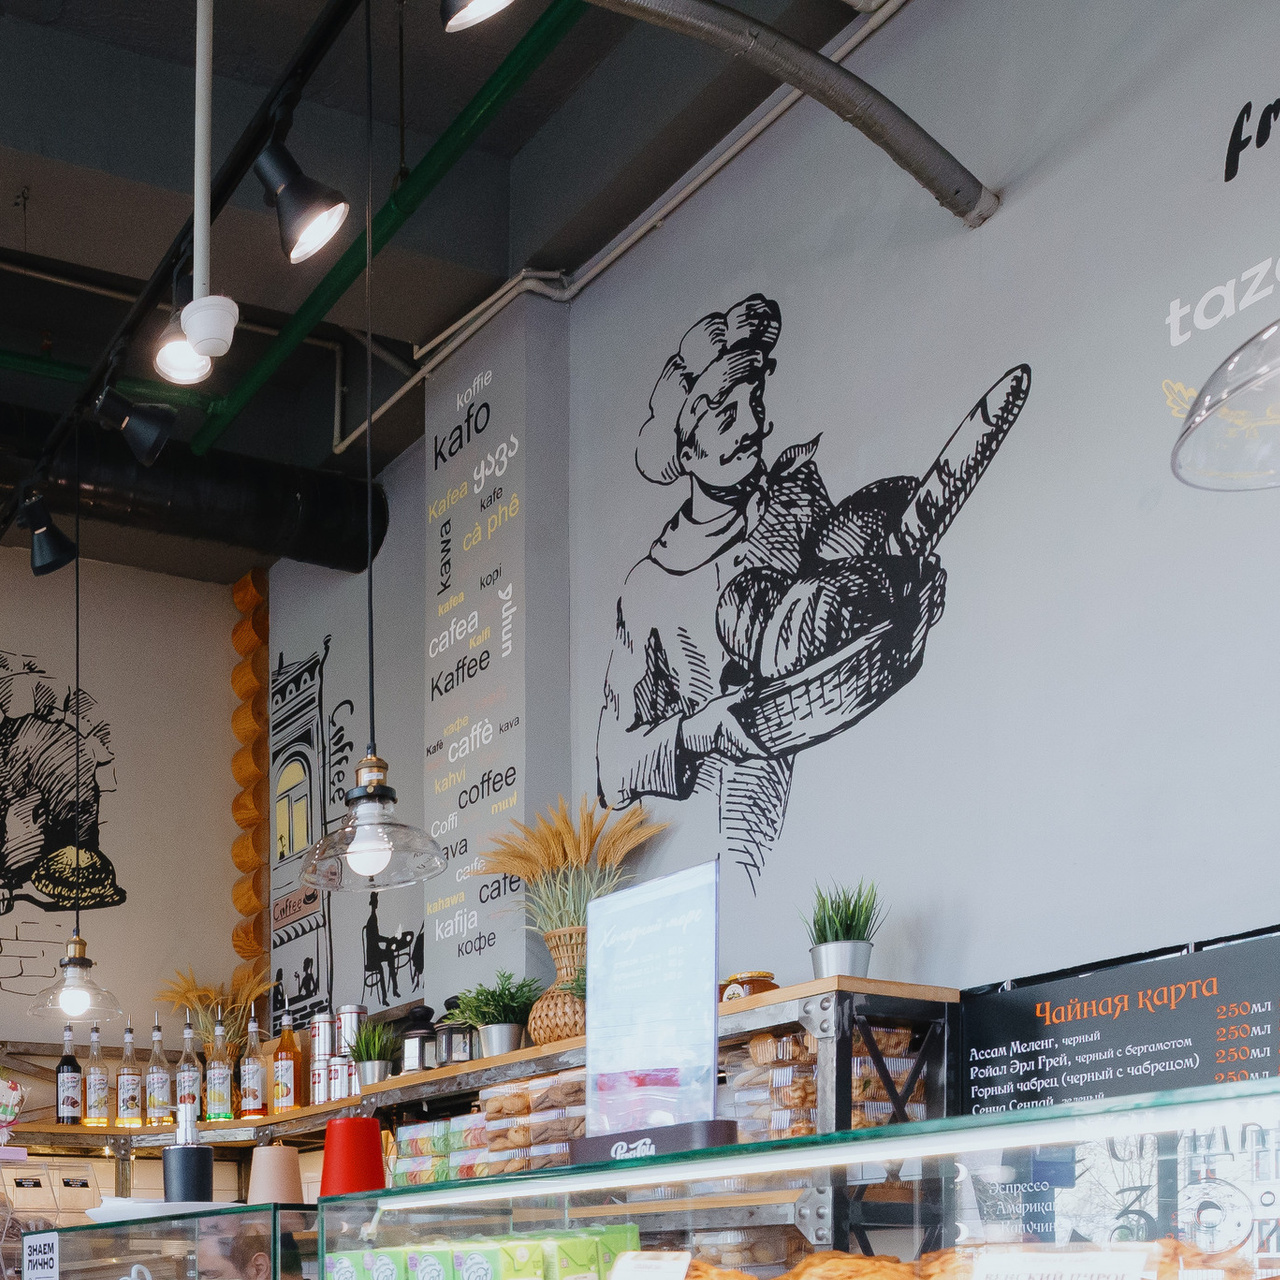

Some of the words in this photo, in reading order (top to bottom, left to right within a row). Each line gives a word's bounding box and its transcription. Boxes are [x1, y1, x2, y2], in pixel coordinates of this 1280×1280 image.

[1165, 257, 1280, 346] taz
[456, 370, 492, 411] koffie
[434, 402, 490, 471] kafo
[428, 481, 468, 524] Kafea
[481, 487, 503, 512] kafe
[488, 492, 519, 540] phê
[437, 517, 452, 596] kawa
[480, 563, 502, 591] kopi
[438, 591, 465, 617] kafea
[429, 610, 479, 658] cafea
[431, 650, 490, 701] Kaffee
[448, 718, 493, 763] caffè
[499, 716, 520, 734] kava
[434, 764, 466, 795] kahvi
[458, 766, 517, 809] coffee
[442, 838, 468, 860] ava
[426, 891, 465, 915] kahawa
[435, 908, 478, 941] kafija
[458, 931, 496, 958] кофе
[1035, 994, 1130, 1026] Чайная
[1137, 977, 1220, 1013] карта
[1216, 1001, 1272, 1020] 250мл
[969, 1045, 1007, 1061] Ассам
[1009, 1038, 1059, 1057] Меленг,
[1062, 1030, 1101, 1047] черный
[1216, 1023, 1271, 1042] 250мл
[970, 1064, 1007, 1080] Ройал
[1009, 1060, 1035, 1075] Эрл
[1037, 1053, 1072, 1071] Грей,
[1075, 1048, 1114, 1064] черный
[1116, 1049, 1123, 1057] с
[1124, 1037, 1193, 1057] бергамотом
[1215, 1046, 1271, 1064] 250мл
[971, 1081, 1014, 1099] Горный
[1016, 1077, 1059, 1092] чабрец
[1061, 1067, 1113, 1087] (черный
[1116, 1068, 1124, 1078] с
[1126, 1052, 1200, 1076] чабрецом)
[988, 1180, 1050, 1195] Эспрессо
[995, 1201, 1055, 1215] Америка
[27, 1242, 55, 1257] ЗНАЕМ
[27, 1257, 55, 1271] ЛИЧНО
